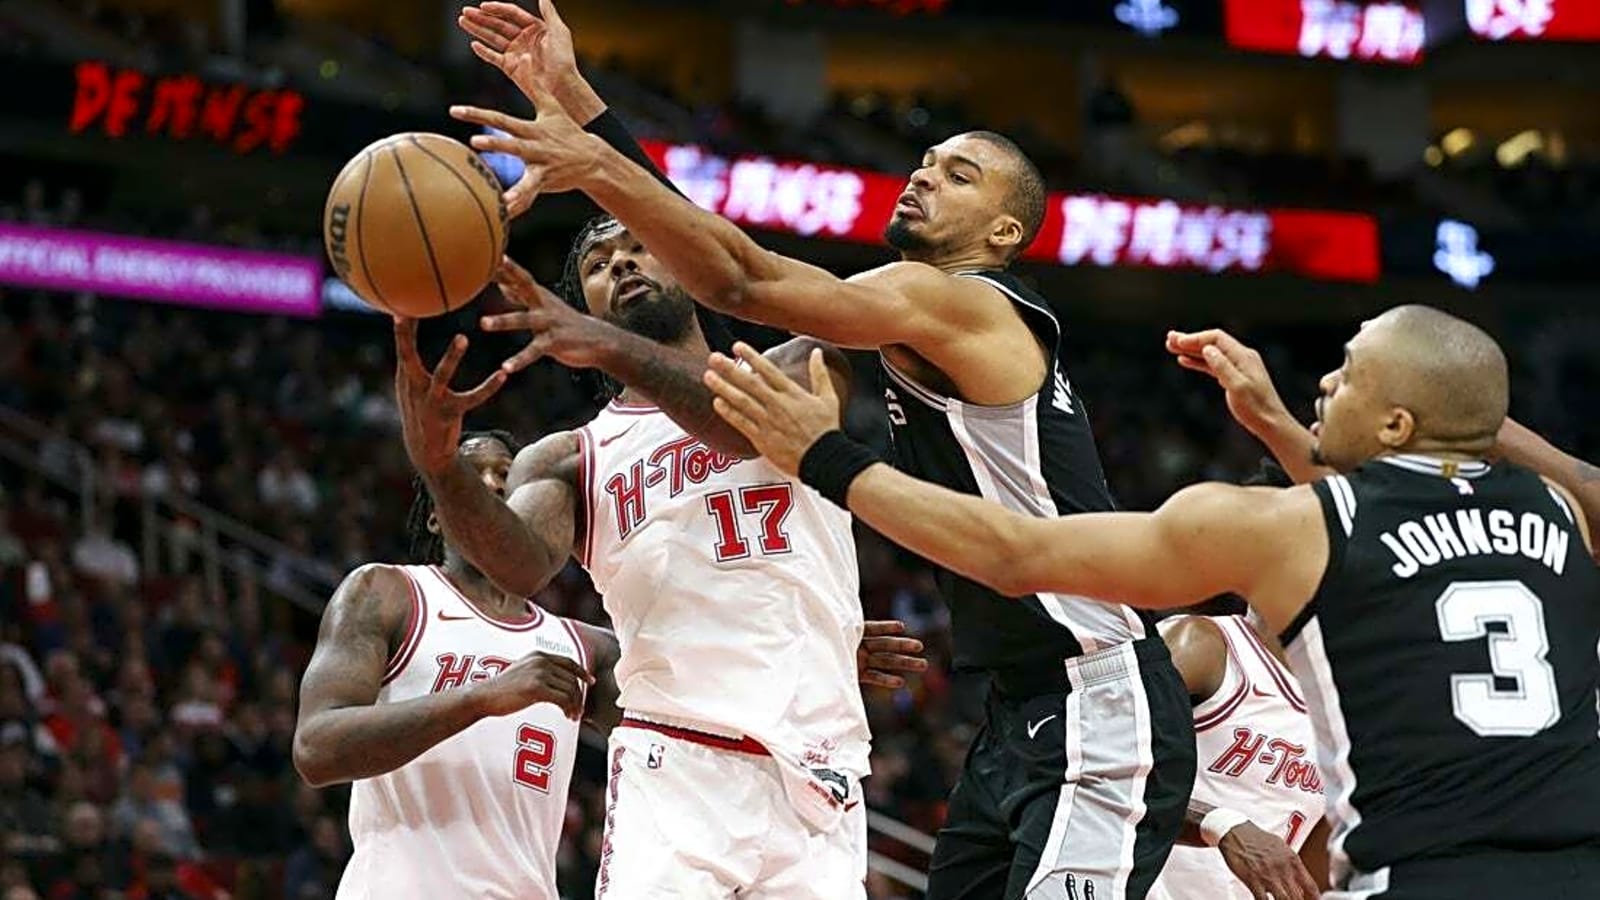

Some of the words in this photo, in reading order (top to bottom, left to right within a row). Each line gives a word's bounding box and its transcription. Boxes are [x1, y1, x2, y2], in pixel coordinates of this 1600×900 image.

[705, 482, 794, 562] 17
[1380, 508, 1569, 578] JOHNSON
[1435, 580, 1561, 737] 3
[513, 722, 557, 794] 2
[1207, 727, 1324, 794] H-Tow
